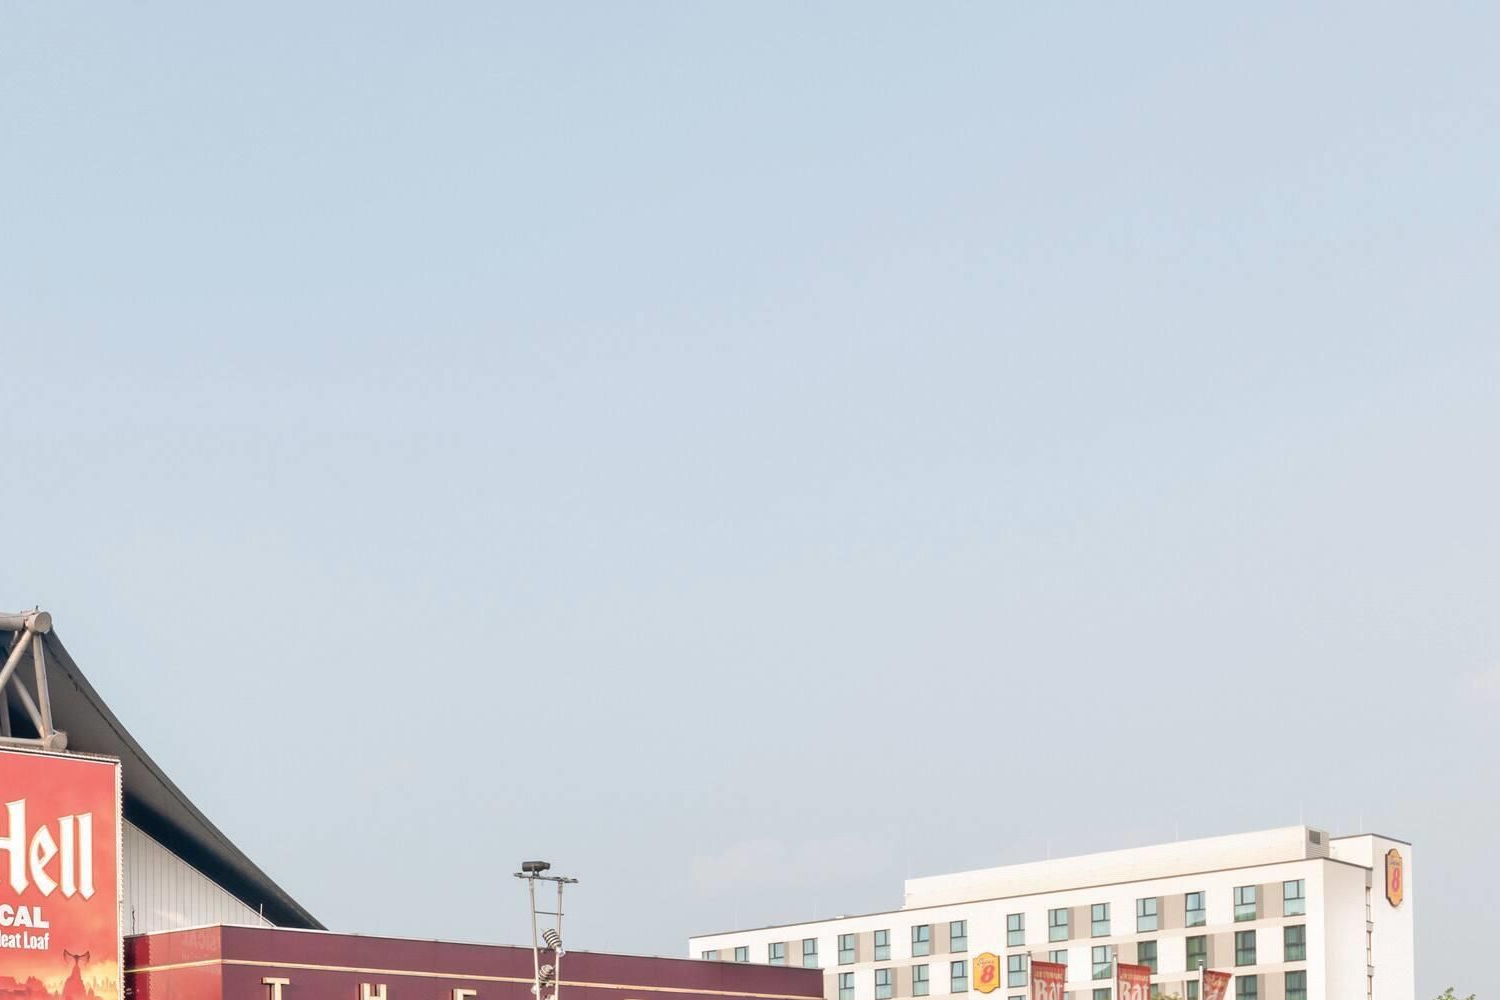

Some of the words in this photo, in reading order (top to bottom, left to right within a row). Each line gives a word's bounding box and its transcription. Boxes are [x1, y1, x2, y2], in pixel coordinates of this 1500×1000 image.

[1392, 868, 1400, 893] 8
[23, 931, 50, 951] Loaf
[980, 965, 995, 984] 8
